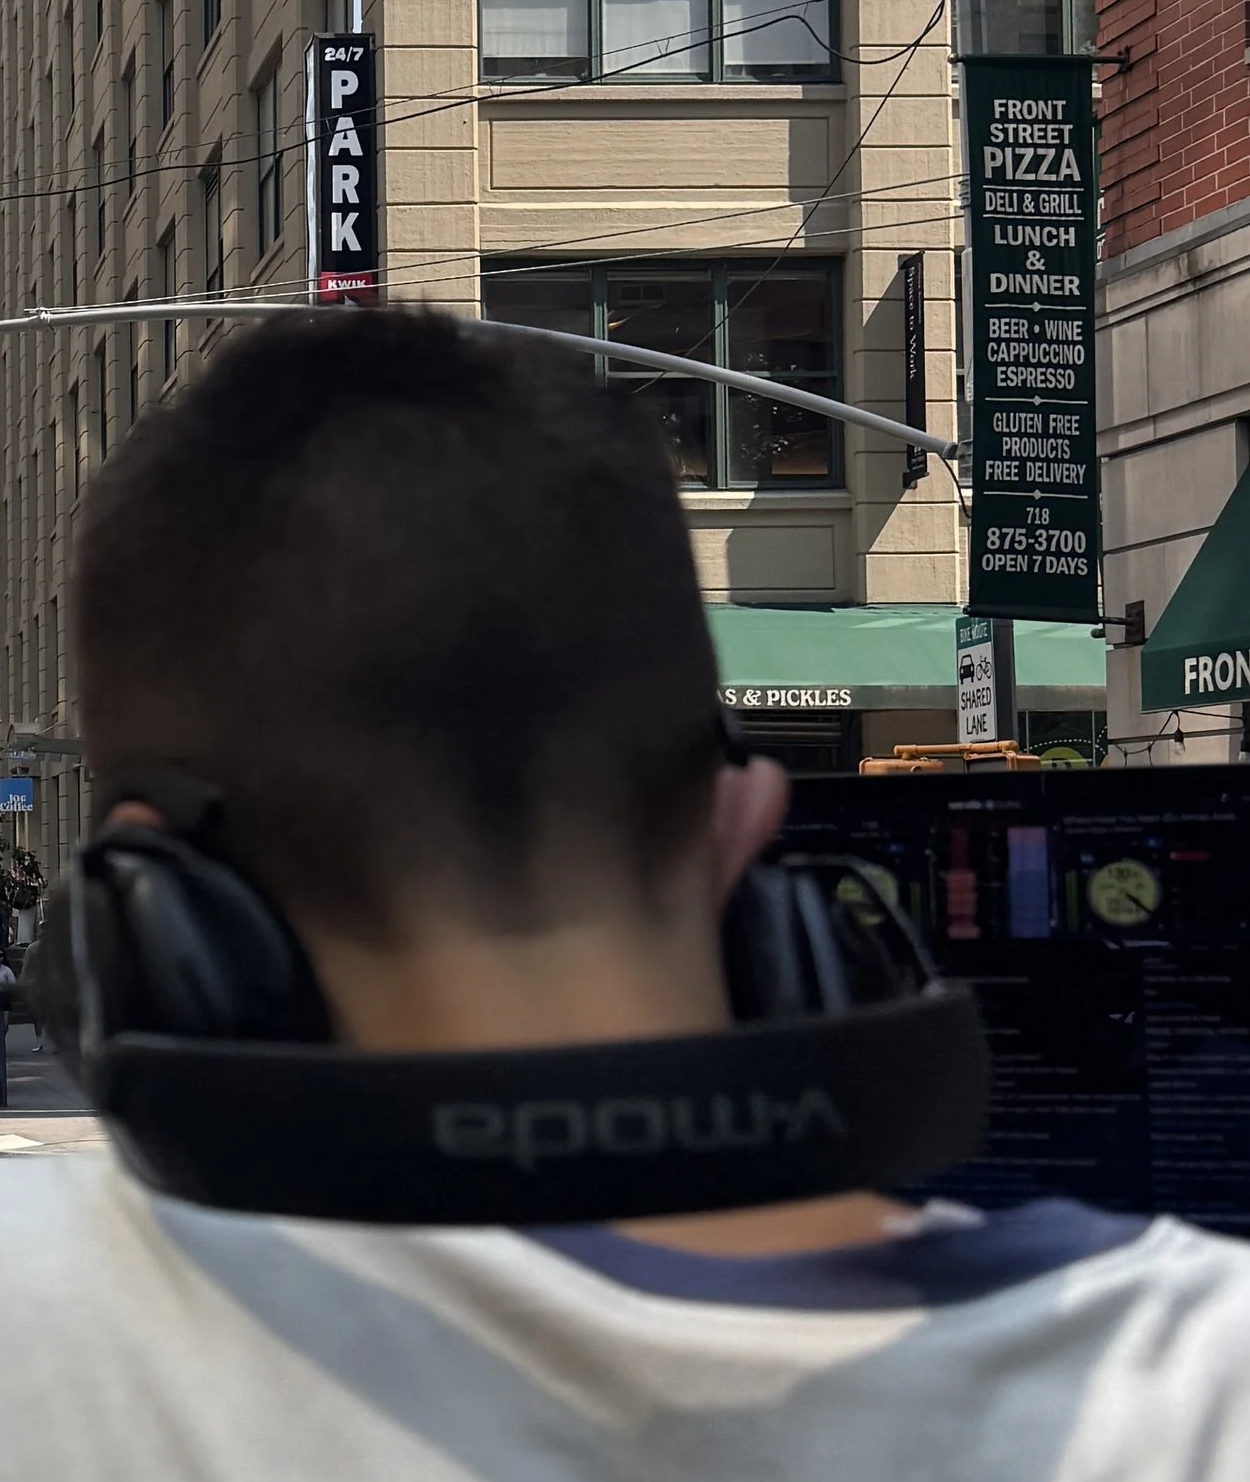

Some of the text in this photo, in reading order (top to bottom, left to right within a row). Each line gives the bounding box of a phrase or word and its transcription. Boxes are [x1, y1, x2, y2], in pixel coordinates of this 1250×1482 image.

[324, 46, 364, 62] 24/7
[993, 99, 1067, 120] FRONT
[989, 123, 1073, 144] STREET
[328, 69, 363, 252] PARK
[983, 146, 1081, 182] PIZZA
[985, 191, 1082, 214] DELI & GRILL
[994, 224, 1075, 247] LUNCH
[1025, 250, 1045, 270] &
[327, 279, 366, 290] KWIK
[990, 273, 1080, 296] DINNER
[989, 318, 1083, 341] BEER WINE
[987, 342, 1084, 365] CAPPUCCINO
[996, 366, 1075, 390] ESPRESSO
[993, 412, 1080, 435] GLUTEN FREE
[1002, 436, 1071, 460] PRODUCTS
[985, 460, 1086, 484] FREE DELIVERY
[1026, 507, 1049, 525] 718
[986, 527, 1086, 553] 875-3700
[981, 553, 1088, 576] OPEN 7 DAYS
[742, 689, 761, 706] &
[766, 689, 852, 707] PICKLES
[960, 686, 991, 710] SHARED
[966, 713, 988, 736] LANE
